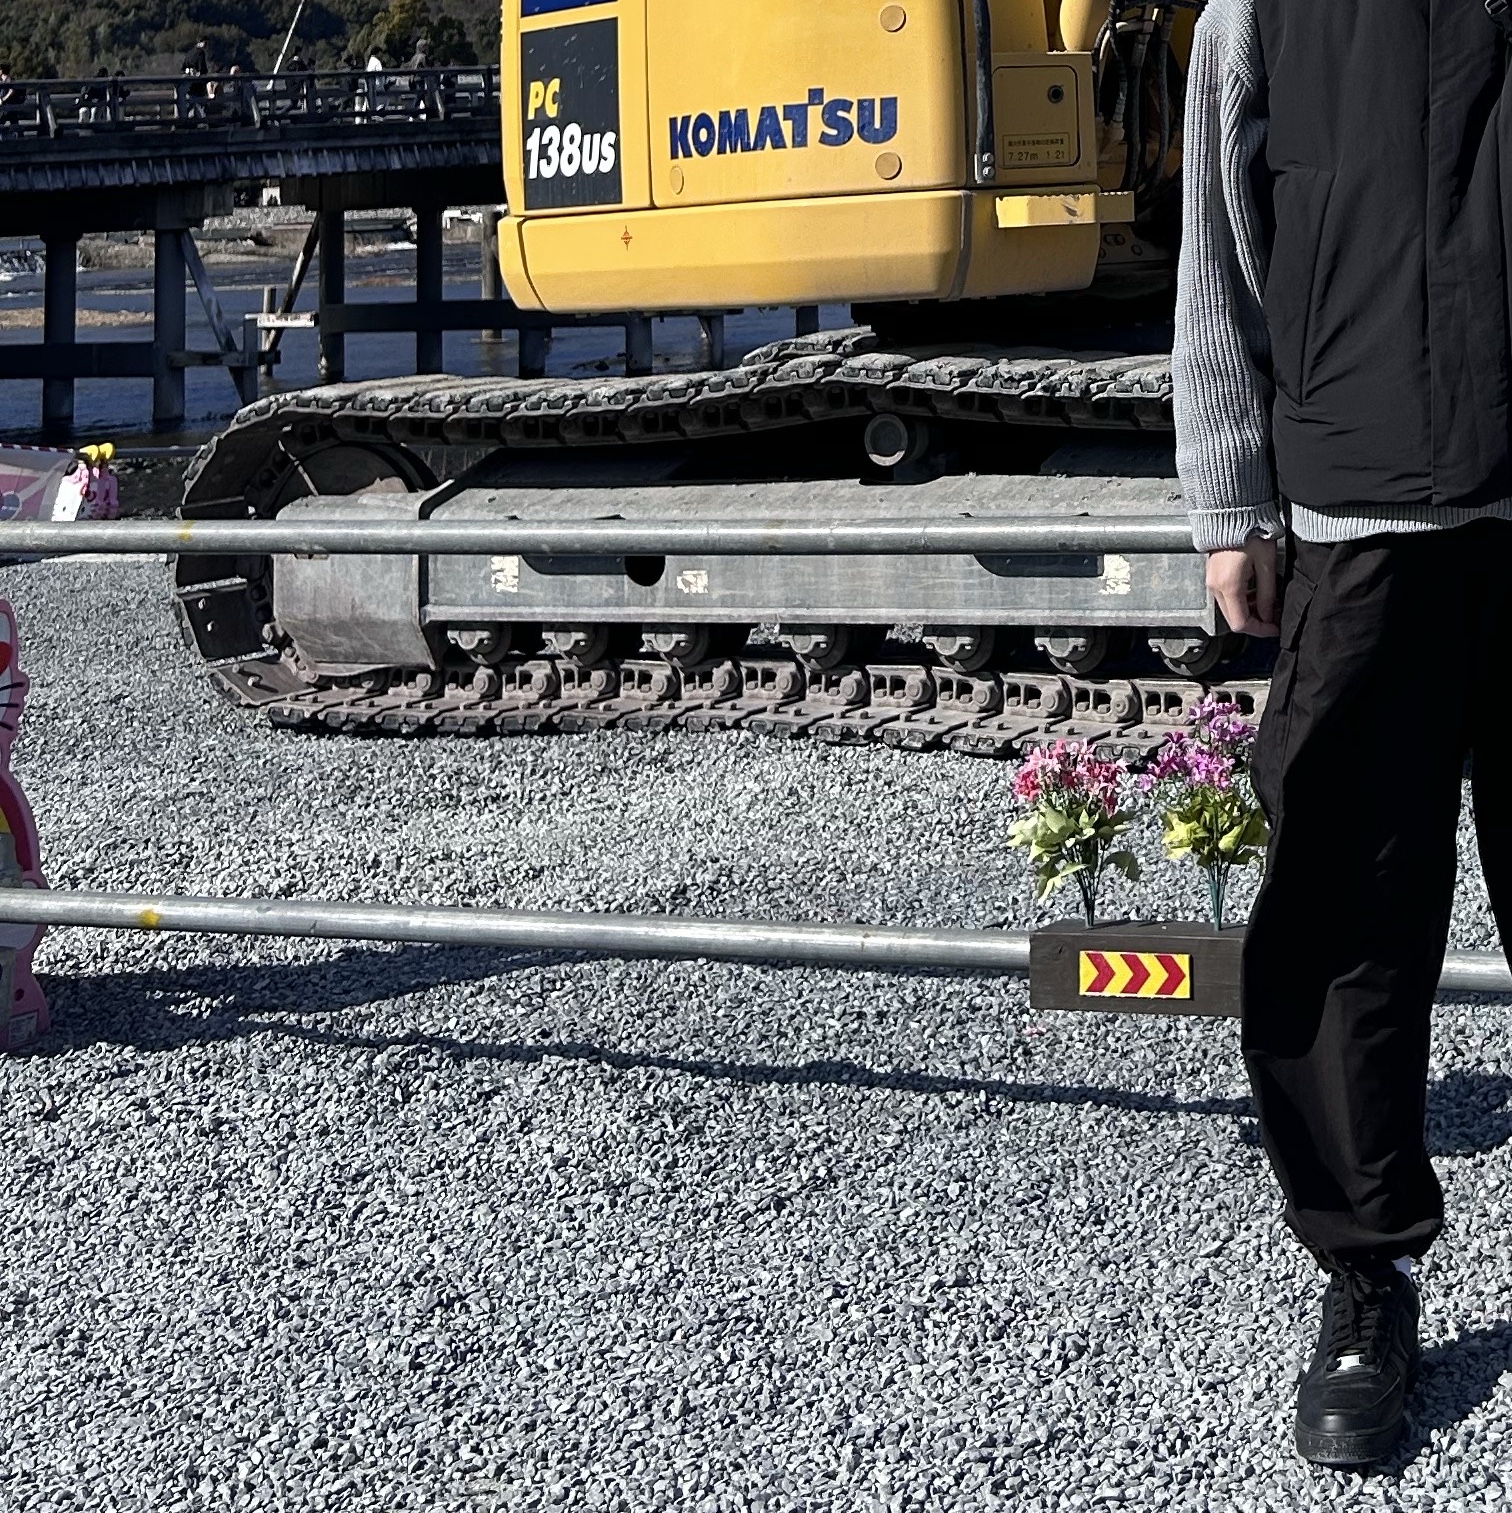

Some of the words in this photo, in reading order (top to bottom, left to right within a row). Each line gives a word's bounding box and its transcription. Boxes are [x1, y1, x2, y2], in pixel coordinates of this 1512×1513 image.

[527, 77, 561, 121] PC
[671, 88, 899, 158] KOMATSU
[525, 122, 618, 180] 138US
